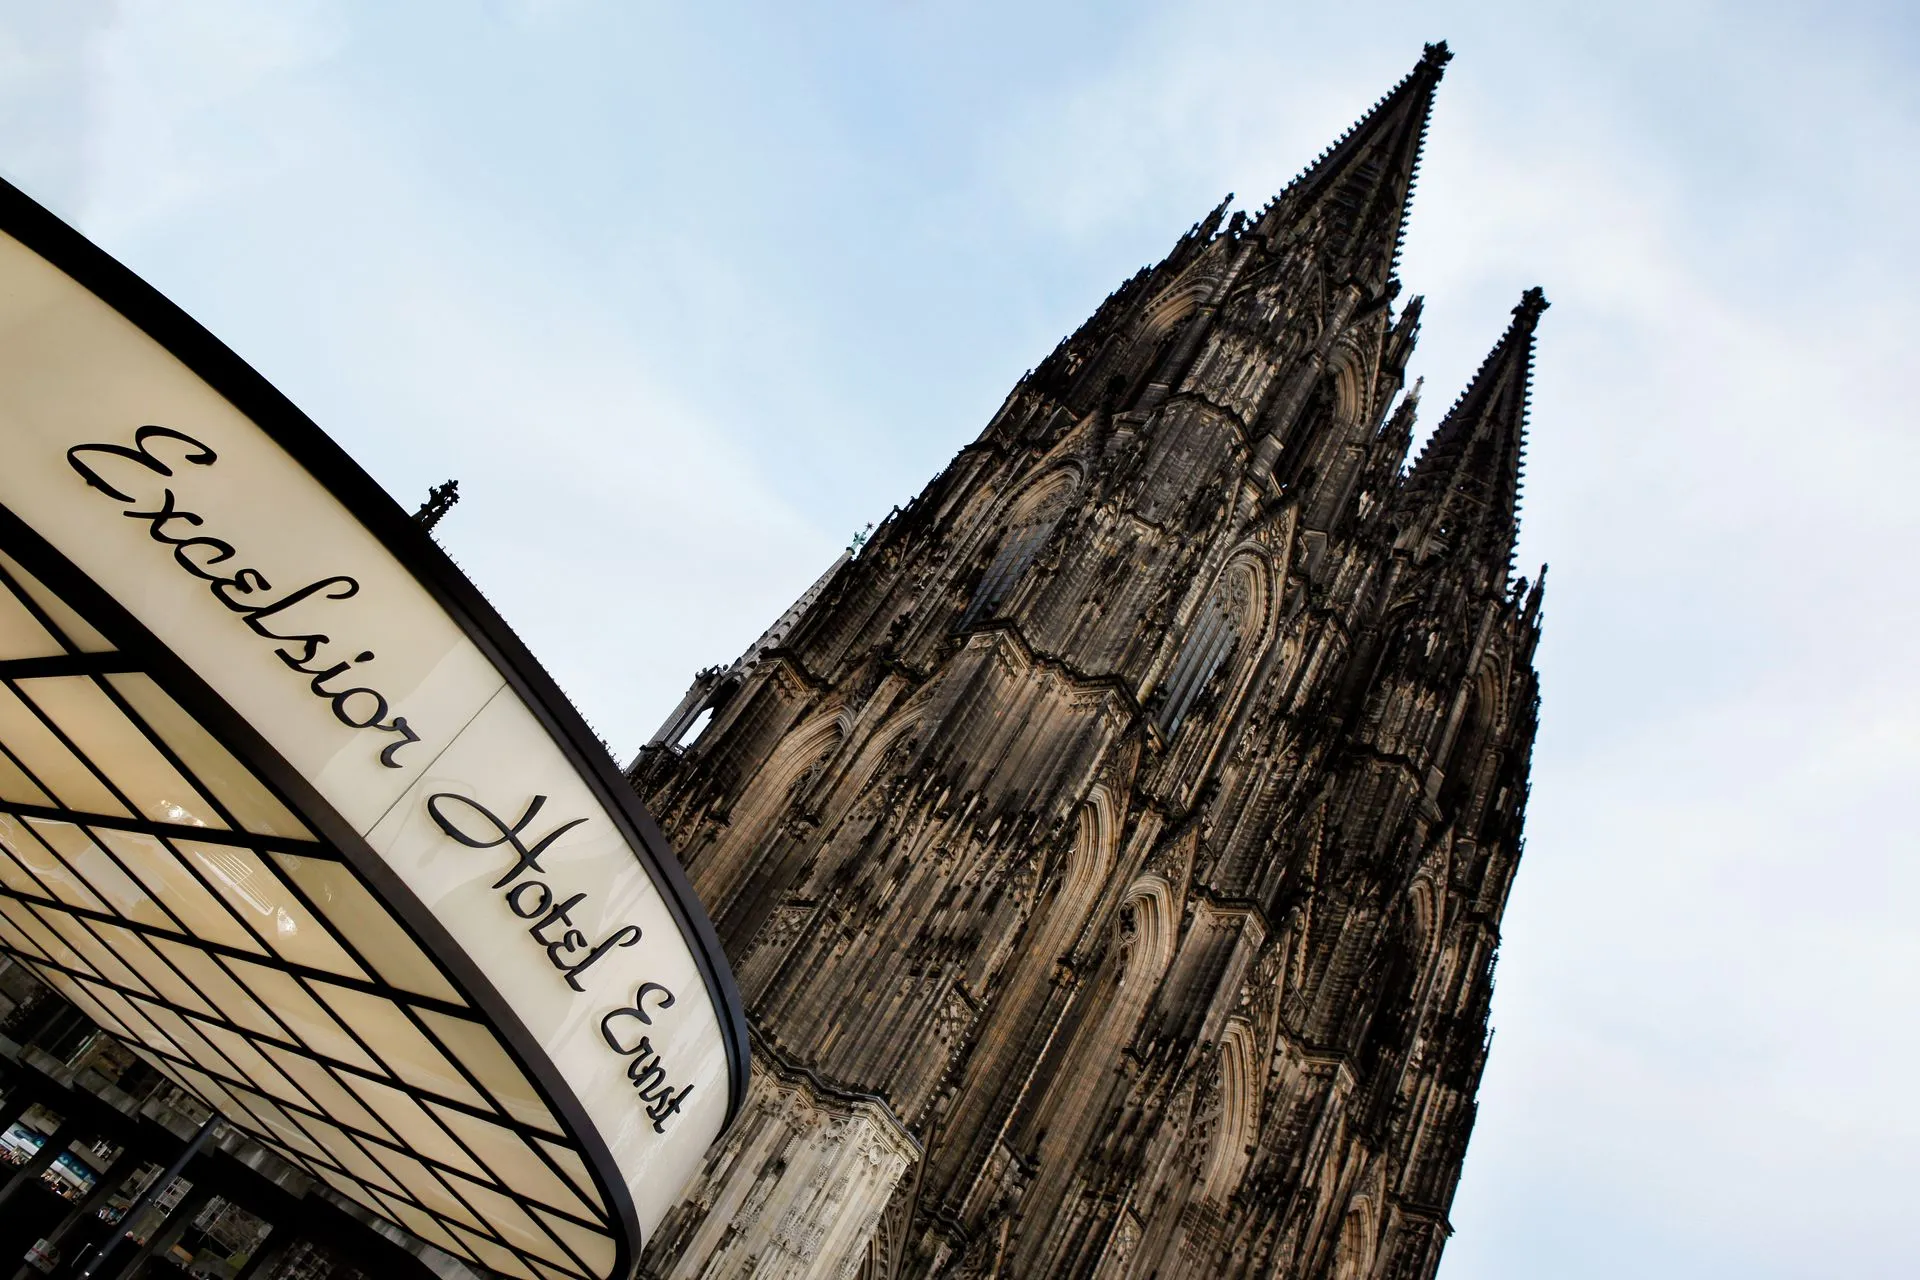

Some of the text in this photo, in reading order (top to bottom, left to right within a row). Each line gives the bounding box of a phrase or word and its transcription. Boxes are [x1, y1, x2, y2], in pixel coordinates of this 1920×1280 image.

[67, 425, 695, 1133] Excelsior Hotel Ernst
